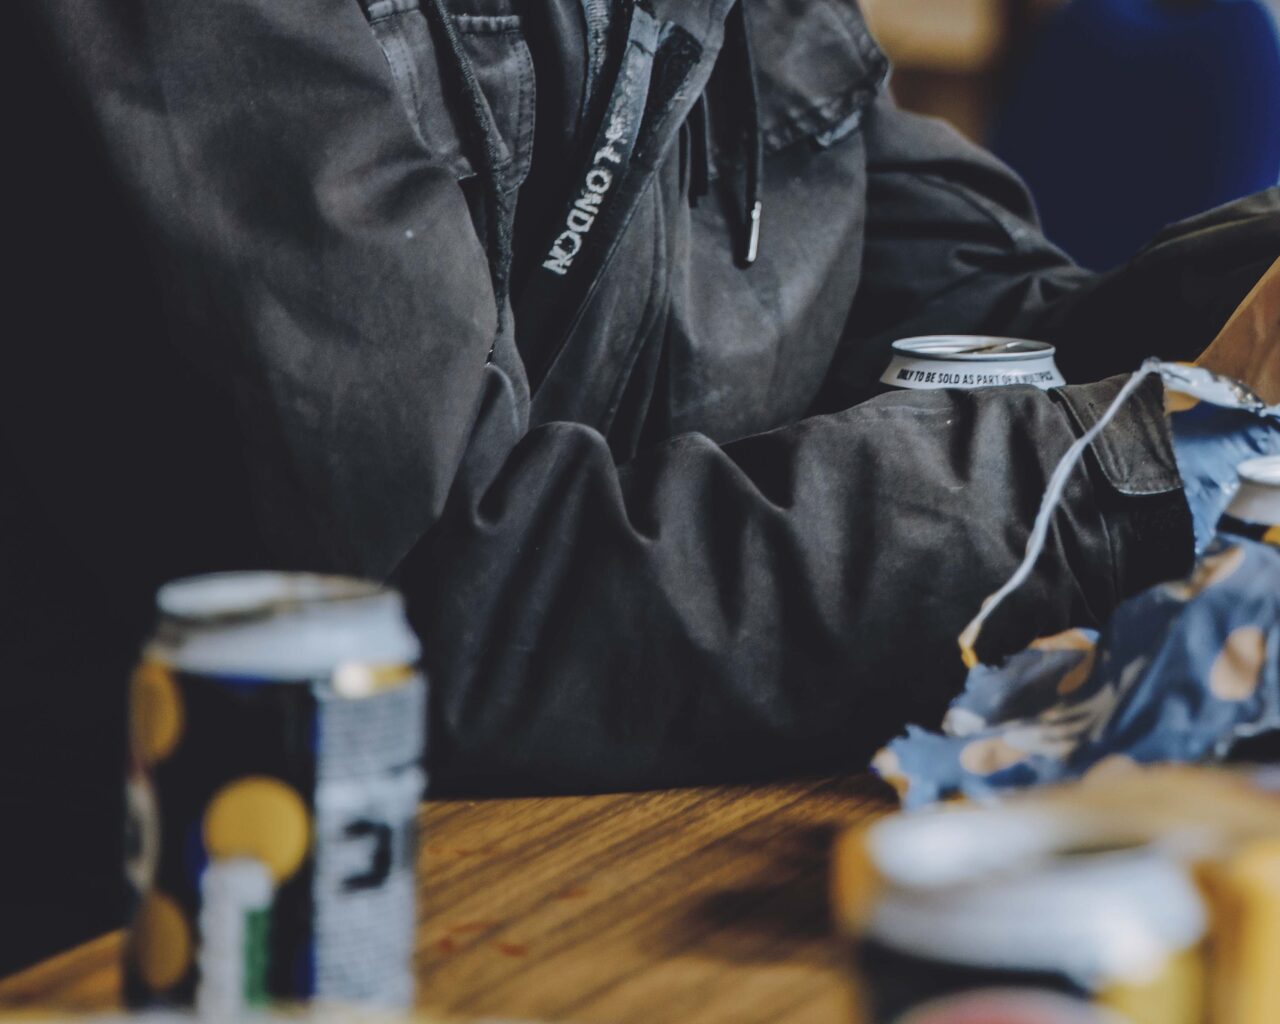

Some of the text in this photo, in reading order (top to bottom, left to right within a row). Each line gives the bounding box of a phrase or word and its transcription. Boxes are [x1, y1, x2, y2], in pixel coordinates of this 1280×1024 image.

[914, 371, 925, 381] TO
[926, 372, 936, 383] BE
[938, 373, 960, 384] SOLD
[962, 373, 974, 385] AS
[977, 374, 999, 385] PART
